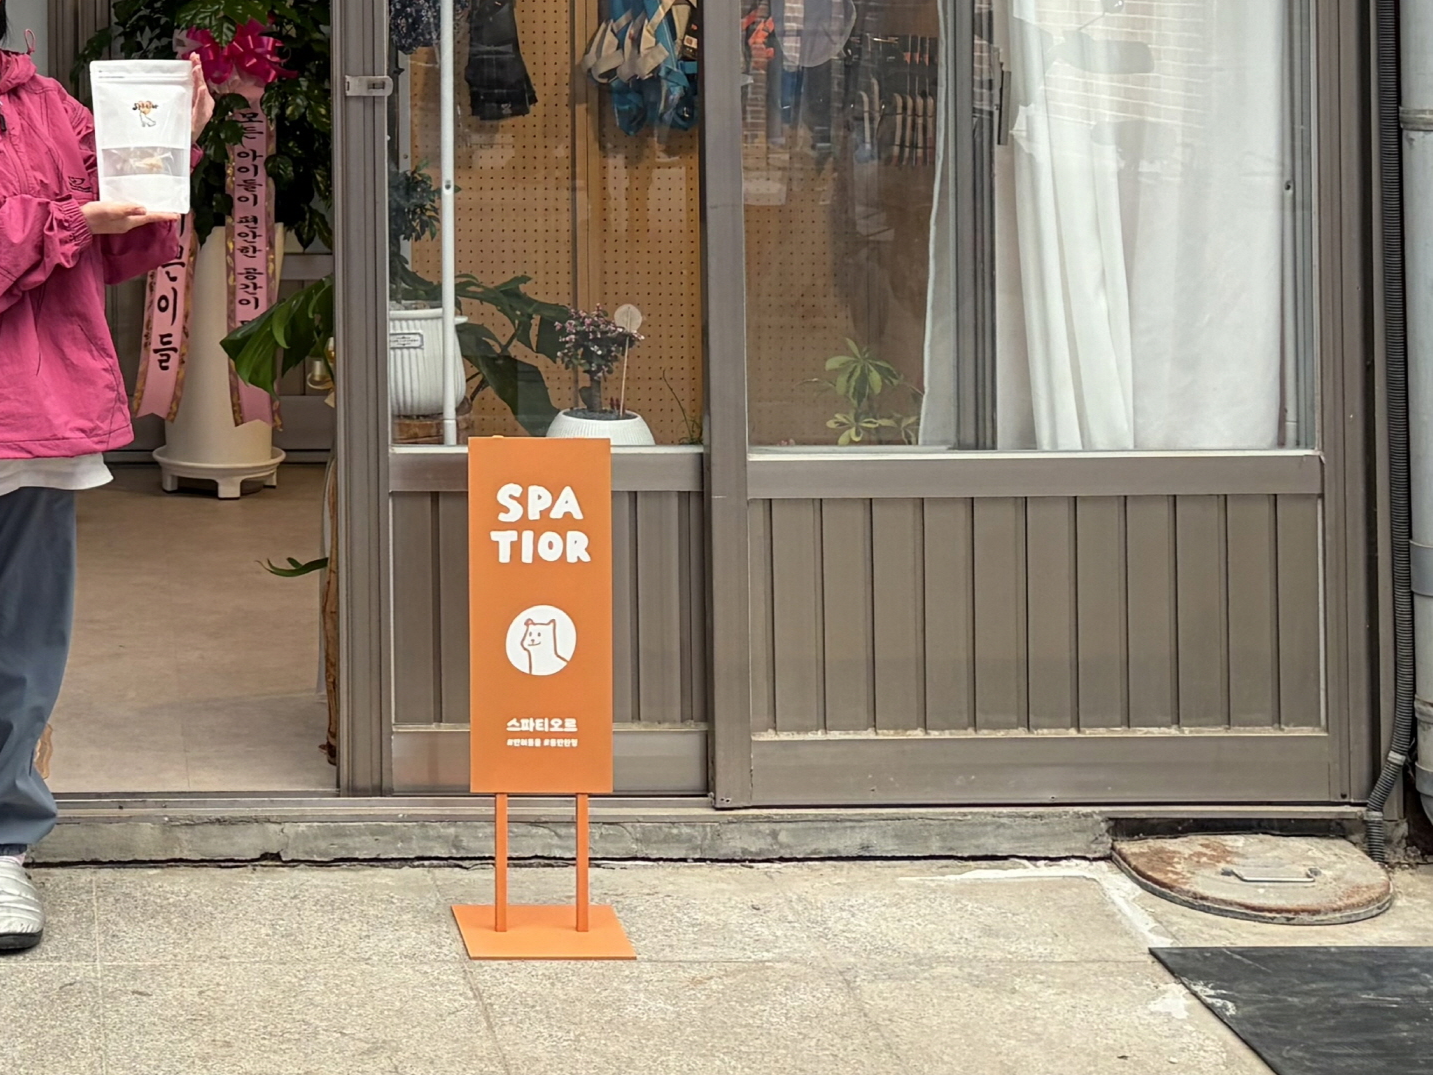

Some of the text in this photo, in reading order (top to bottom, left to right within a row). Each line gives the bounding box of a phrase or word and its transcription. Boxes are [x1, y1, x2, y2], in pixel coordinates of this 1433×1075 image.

[236, 148, 264, 207] 아이들이
[236, 214, 264, 259] 편안한
[236, 266, 265, 311] 공간이
[496, 482, 584, 522] SPA
[489, 530, 591, 563] TIOR
[506, 717, 578, 732] 스파티오르
